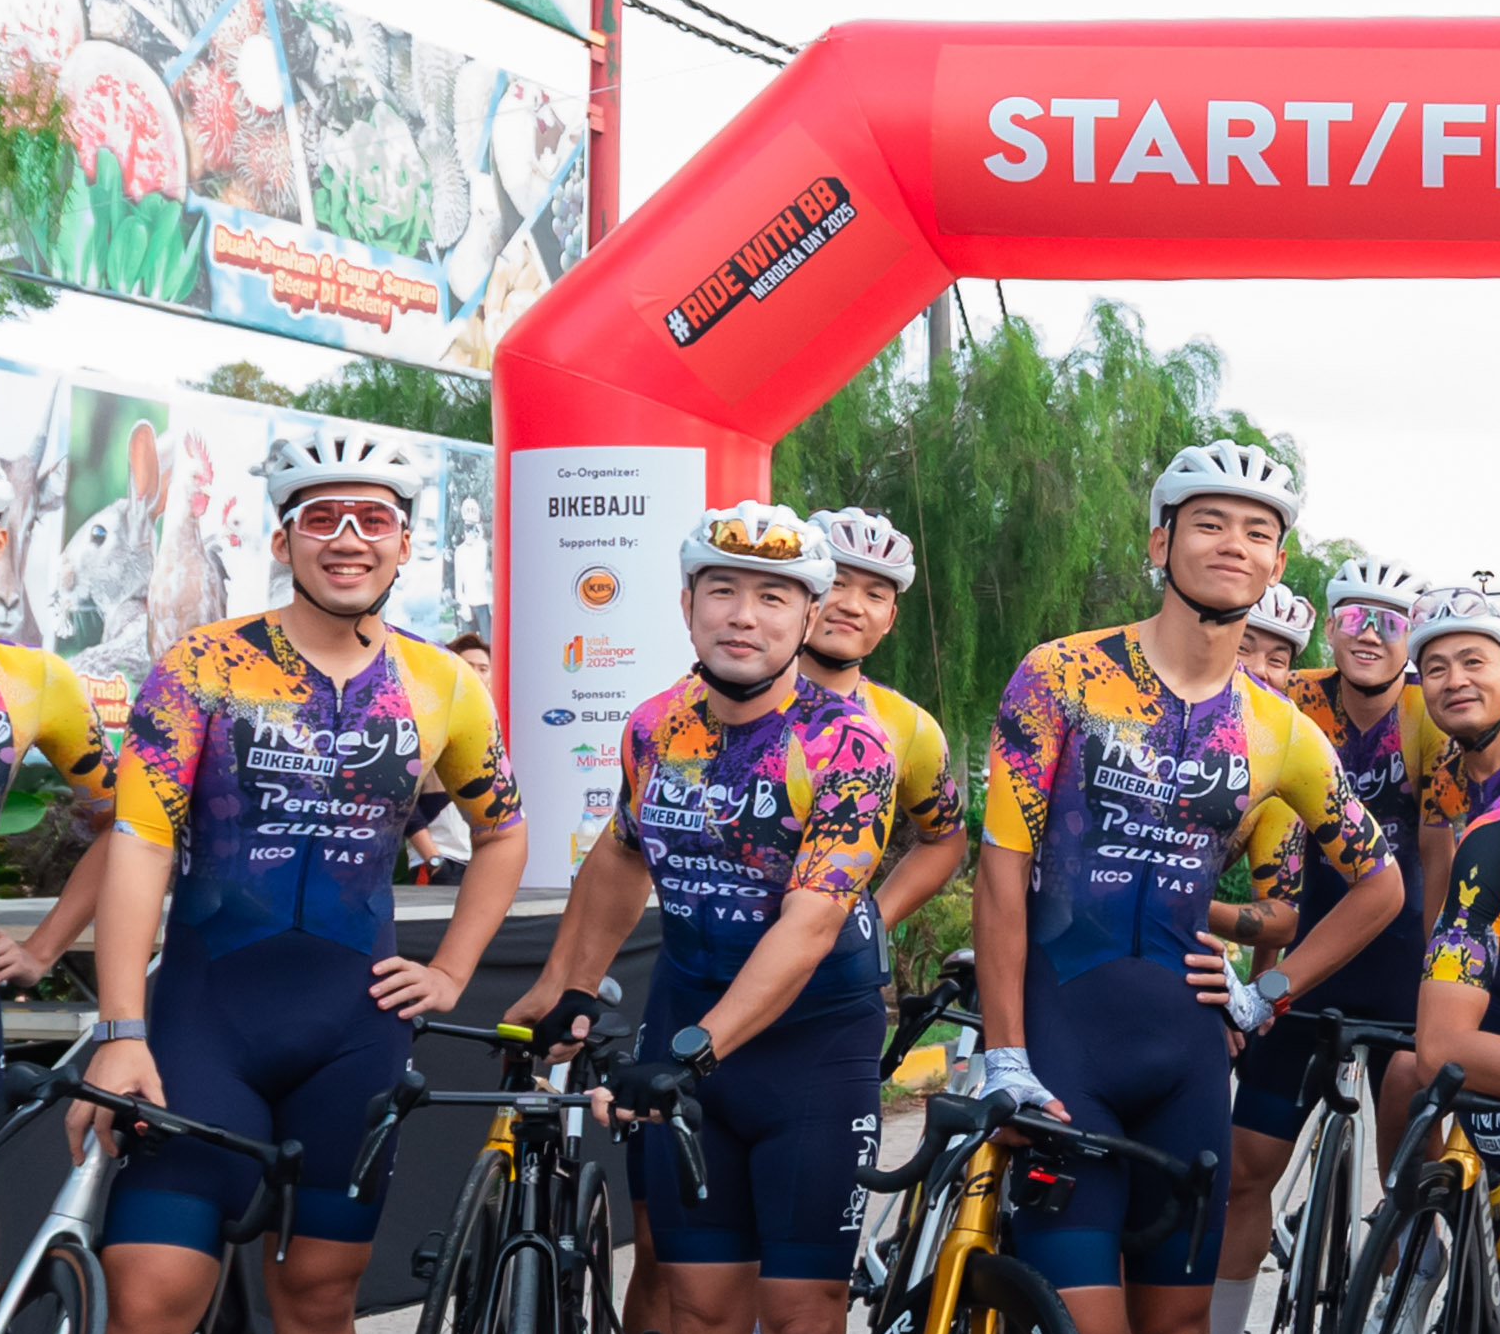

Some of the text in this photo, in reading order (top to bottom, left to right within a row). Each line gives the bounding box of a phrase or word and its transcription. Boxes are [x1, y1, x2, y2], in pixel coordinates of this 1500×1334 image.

[667, 179, 837, 343] #RIDE WITH BB
[749, 202, 856, 300] MERDEKA DAY 2025
[214, 225, 317, 277] Buah-Buahan
[319, 253, 334, 279] &
[383, 270, 438, 314] Sayuran
[319, 280, 337, 314] Di
[557, 468, 640, 479] Co-Organizer:
[548, 495, 646, 517] BIKEBAJU
[559, 536, 638, 549] Supported By:
[588, 583, 612, 592] KBS
[586, 647, 635, 658] Selangor
[586, 658, 616, 667] 2025
[572, 690, 626, 701] Sponsors:
[601, 744, 616, 755] Le
[250, 750, 335, 774] BIKEBAJU
[1097, 769, 1174, 802] BIKEBAJU
[255, 782, 386, 821] Perstorp
[589, 794, 609, 806] 96
[642, 805, 704, 829] BIKEBAJU
[1100, 801, 1210, 850] Perstorp
[257, 823, 376, 840] GUSTO
[643, 837, 765, 880] Perstorp
[1097, 845, 1202, 870] GUSTO
[661, 877, 768, 897] GUSTO
